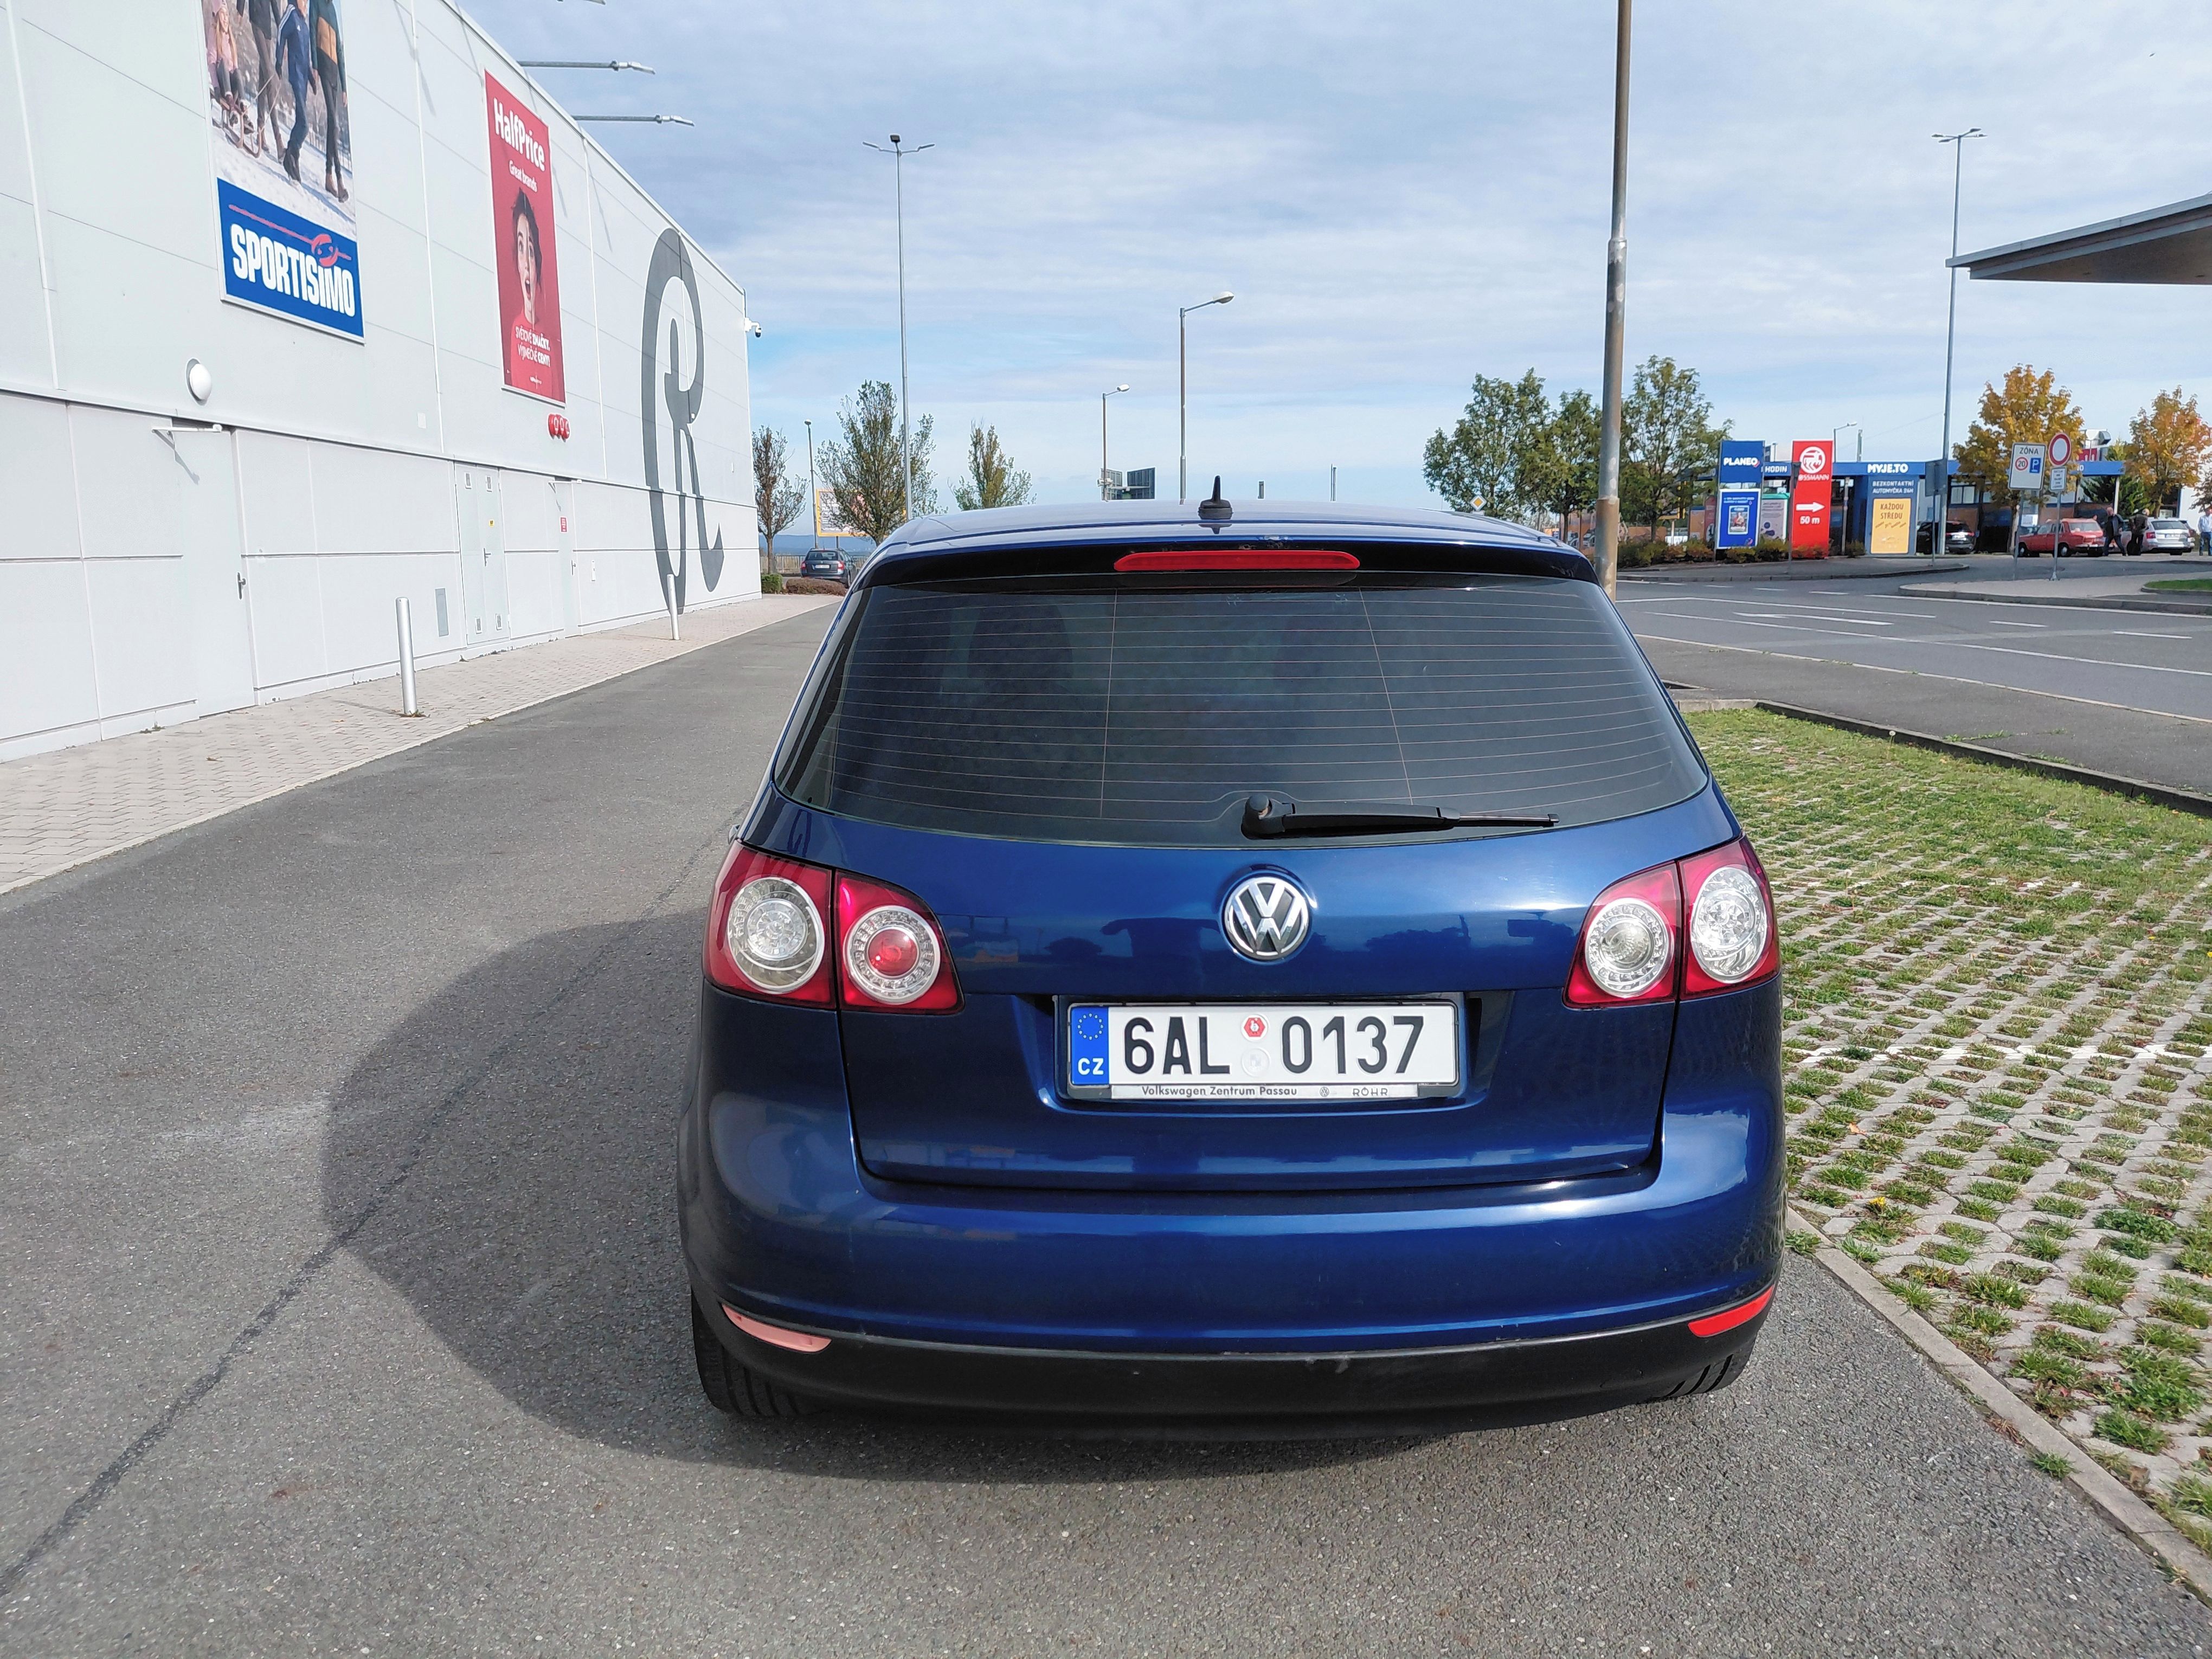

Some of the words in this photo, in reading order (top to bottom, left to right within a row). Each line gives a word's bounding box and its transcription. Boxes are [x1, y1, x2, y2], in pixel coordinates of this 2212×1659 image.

[494, 98, 545, 171] HalfPrice
[509, 160, 522, 182] Great
[522, 169, 538, 192] brands
[231, 223, 355, 317] SPORTISIMO
[2019, 446, 2039, 455] ZÓNA
[1723, 457, 1758, 466] PLANEO
[1867, 464, 1908, 473] MYJE.TO
[1880, 502, 1904, 510] KAŽDOU
[1800, 516, 1811, 525] 50
[1124, 1017, 1231, 1075] 6AL
[1282, 1015, 1424, 1075] 0137
[1077, 1057, 1104, 1075] CZ
[1142, 1086, 1206, 1098] Volkswagen
[1210, 1086, 1255, 1096] Zentrum
[1259, 1086, 1297, 1096] Passau
